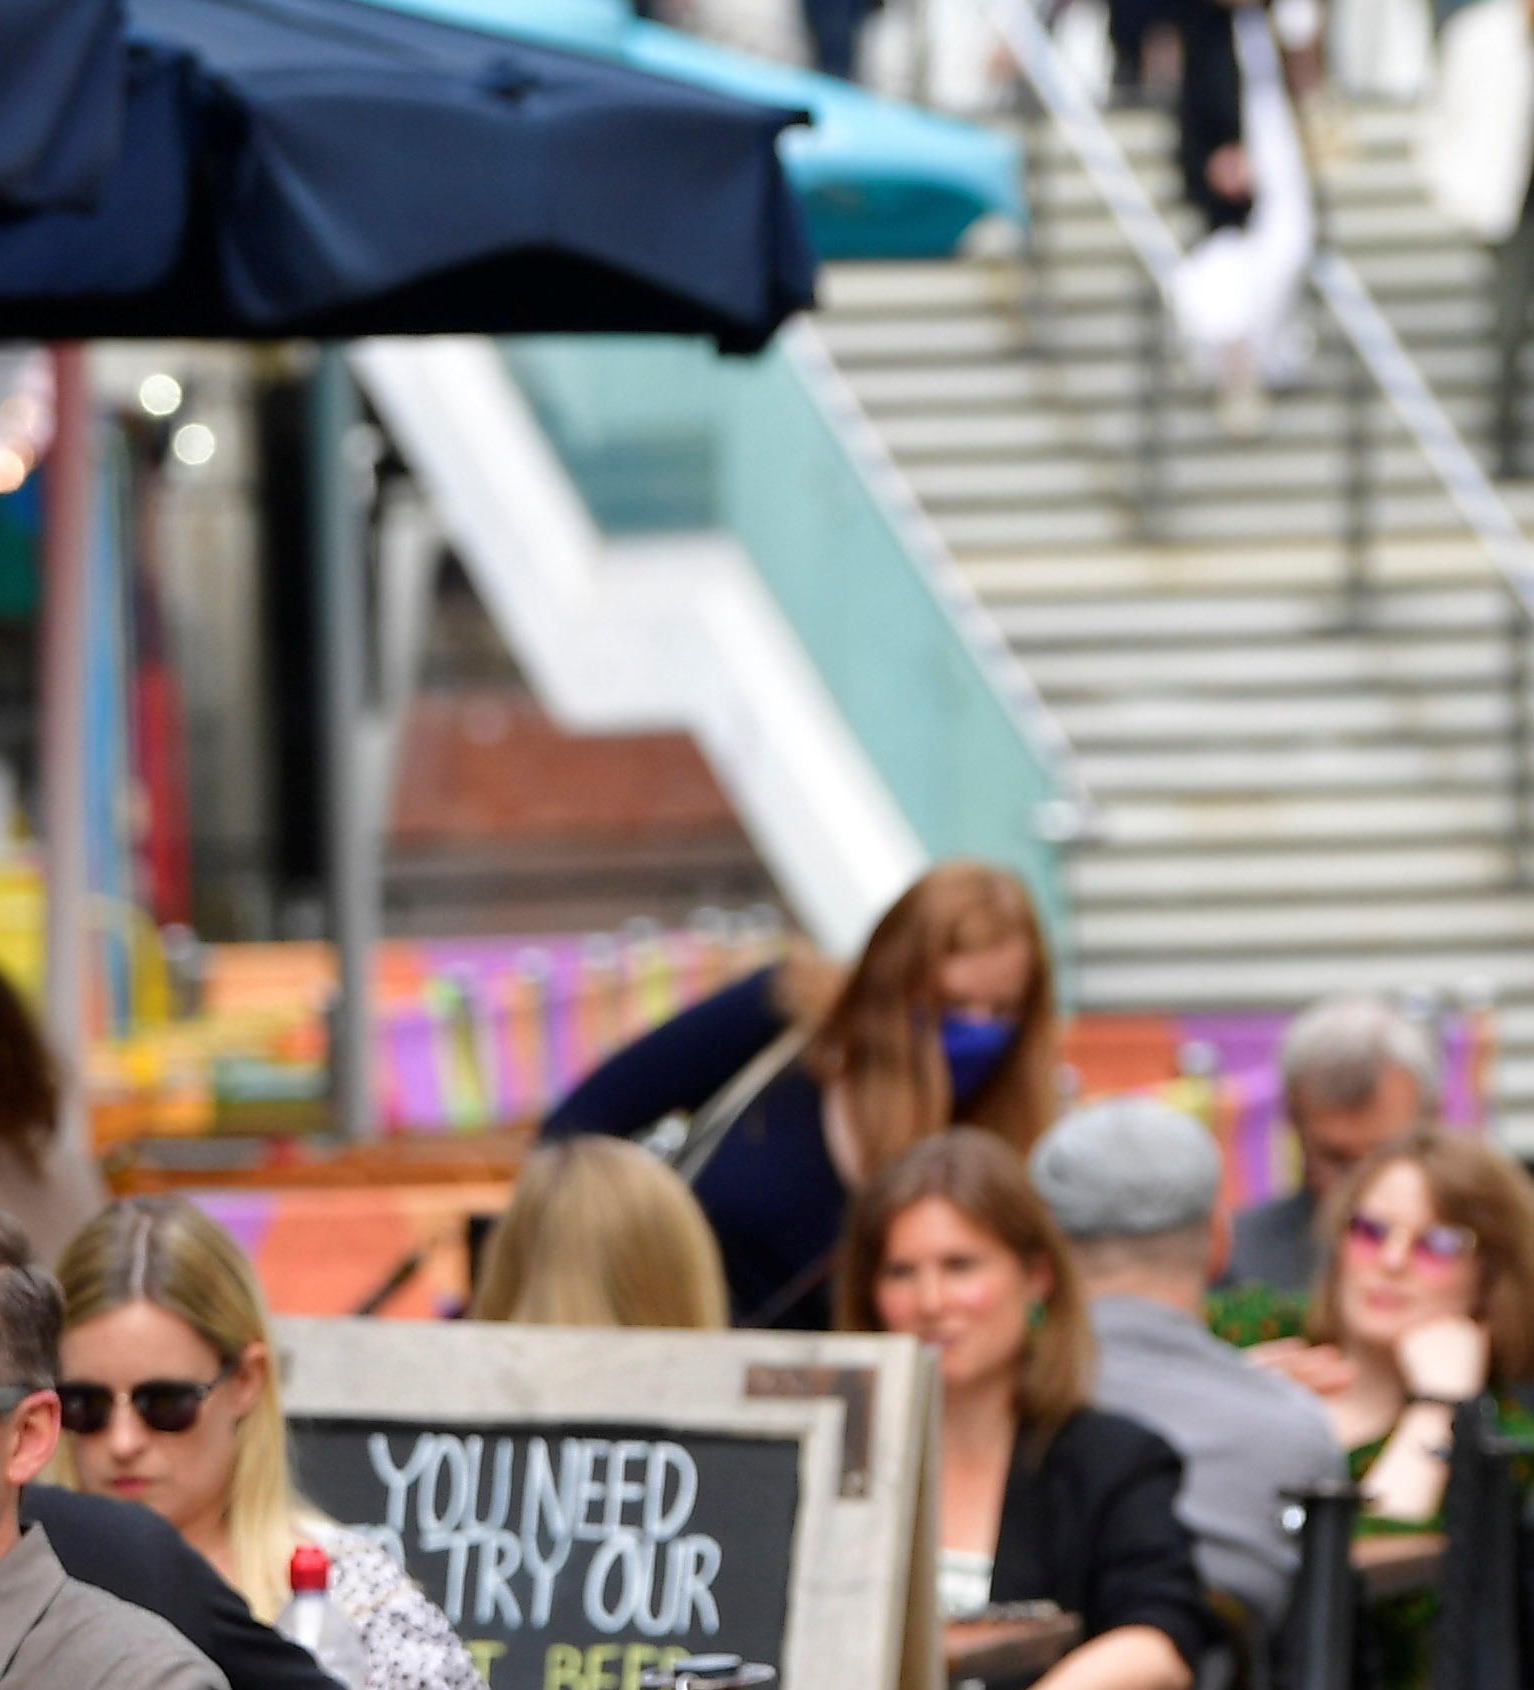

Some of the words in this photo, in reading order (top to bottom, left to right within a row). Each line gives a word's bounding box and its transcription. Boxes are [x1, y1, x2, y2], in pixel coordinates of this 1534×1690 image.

[367, 1431, 514, 1532] YOU
[520, 1437, 699, 1543] NEED
[419, 1528, 572, 1632] TRY
[583, 1527, 722, 1637] OUR
